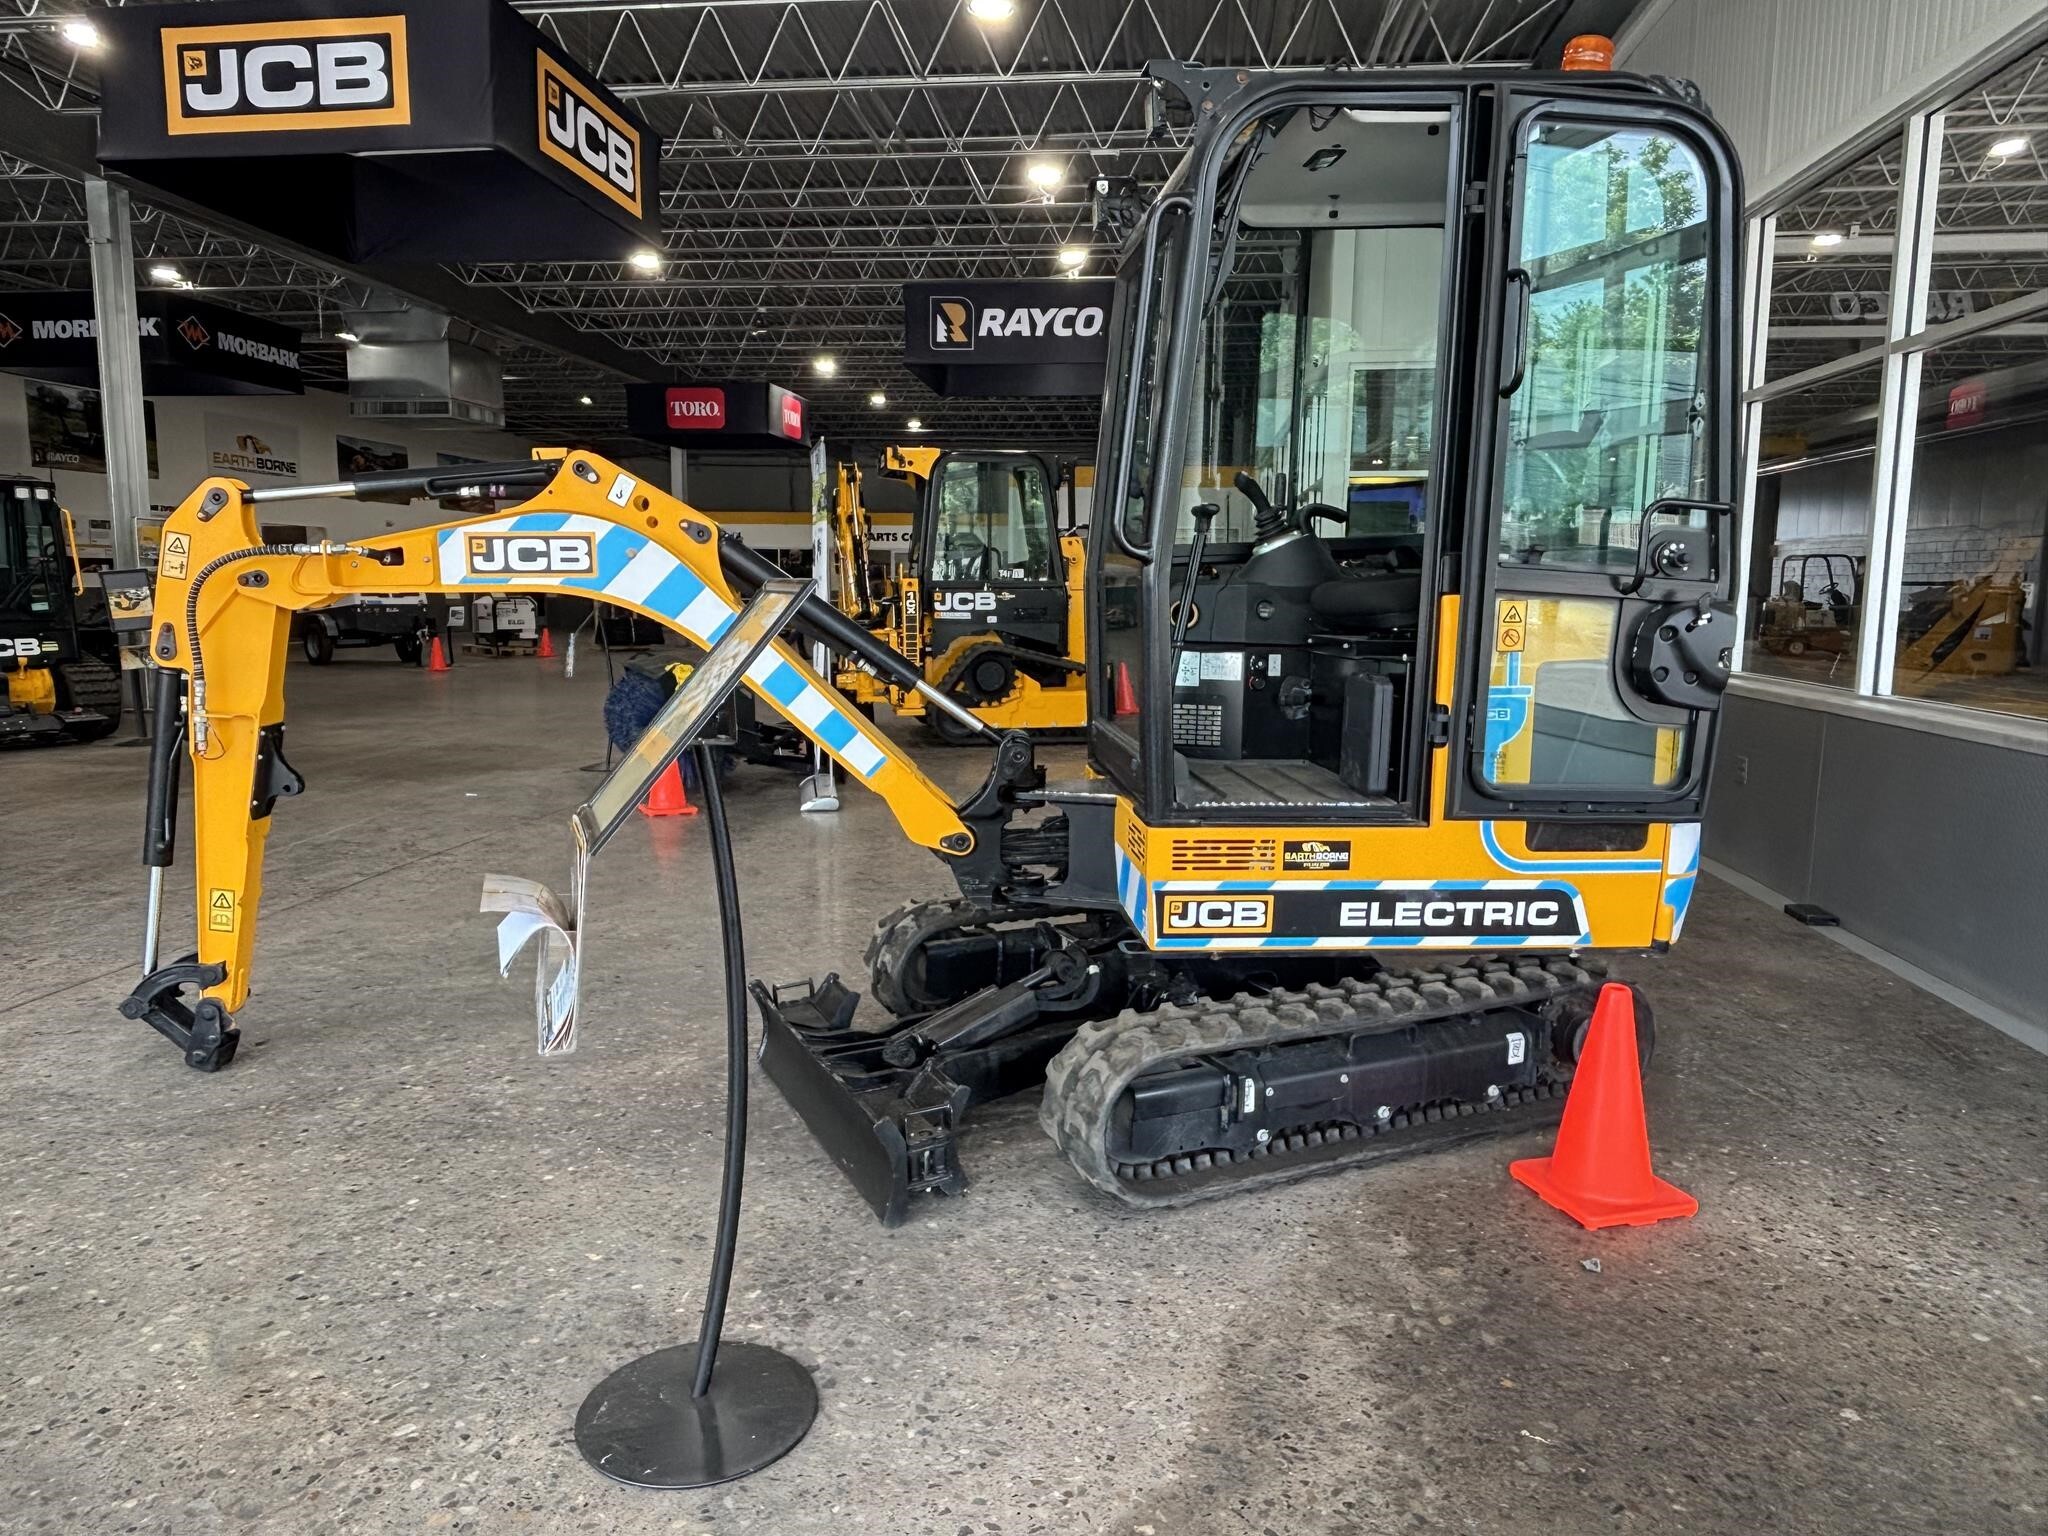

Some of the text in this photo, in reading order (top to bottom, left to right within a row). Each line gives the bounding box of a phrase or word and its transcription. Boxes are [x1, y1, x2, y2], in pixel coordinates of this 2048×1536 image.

[186, 41, 388, 111] JCB
[548, 92, 635, 194] JCB
[978, 306, 1104, 337] RAYCO
[217, 331, 300, 369] MORBARK
[473, 539, 591, 571] JCB
[934, 592, 997, 611] JCB
[0, 638, 42, 657] CB
[1487, 709, 1509, 720] CB
[1170, 901, 1560, 928] JCB ELECTRIC
